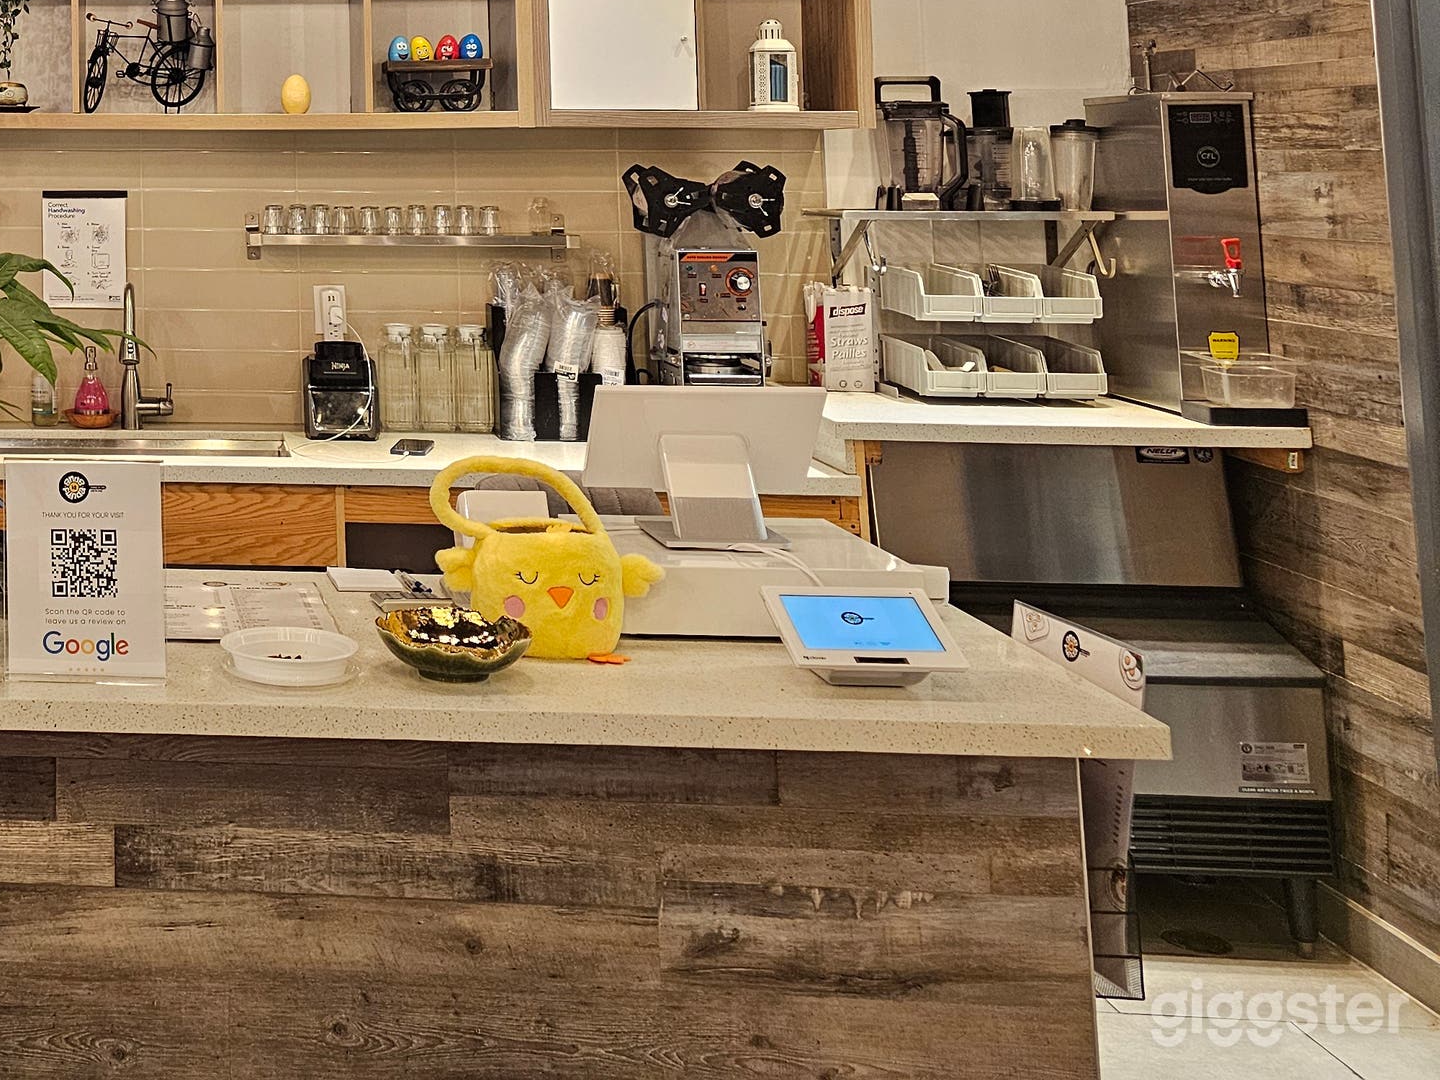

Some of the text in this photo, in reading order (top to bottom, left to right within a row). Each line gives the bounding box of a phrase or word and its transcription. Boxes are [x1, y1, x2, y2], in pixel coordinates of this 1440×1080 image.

[832, 306, 863, 316] dispose
[831, 337, 868, 348] Straws
[833, 349, 866, 359] Pailles
[43, 630, 129, 661] Google
